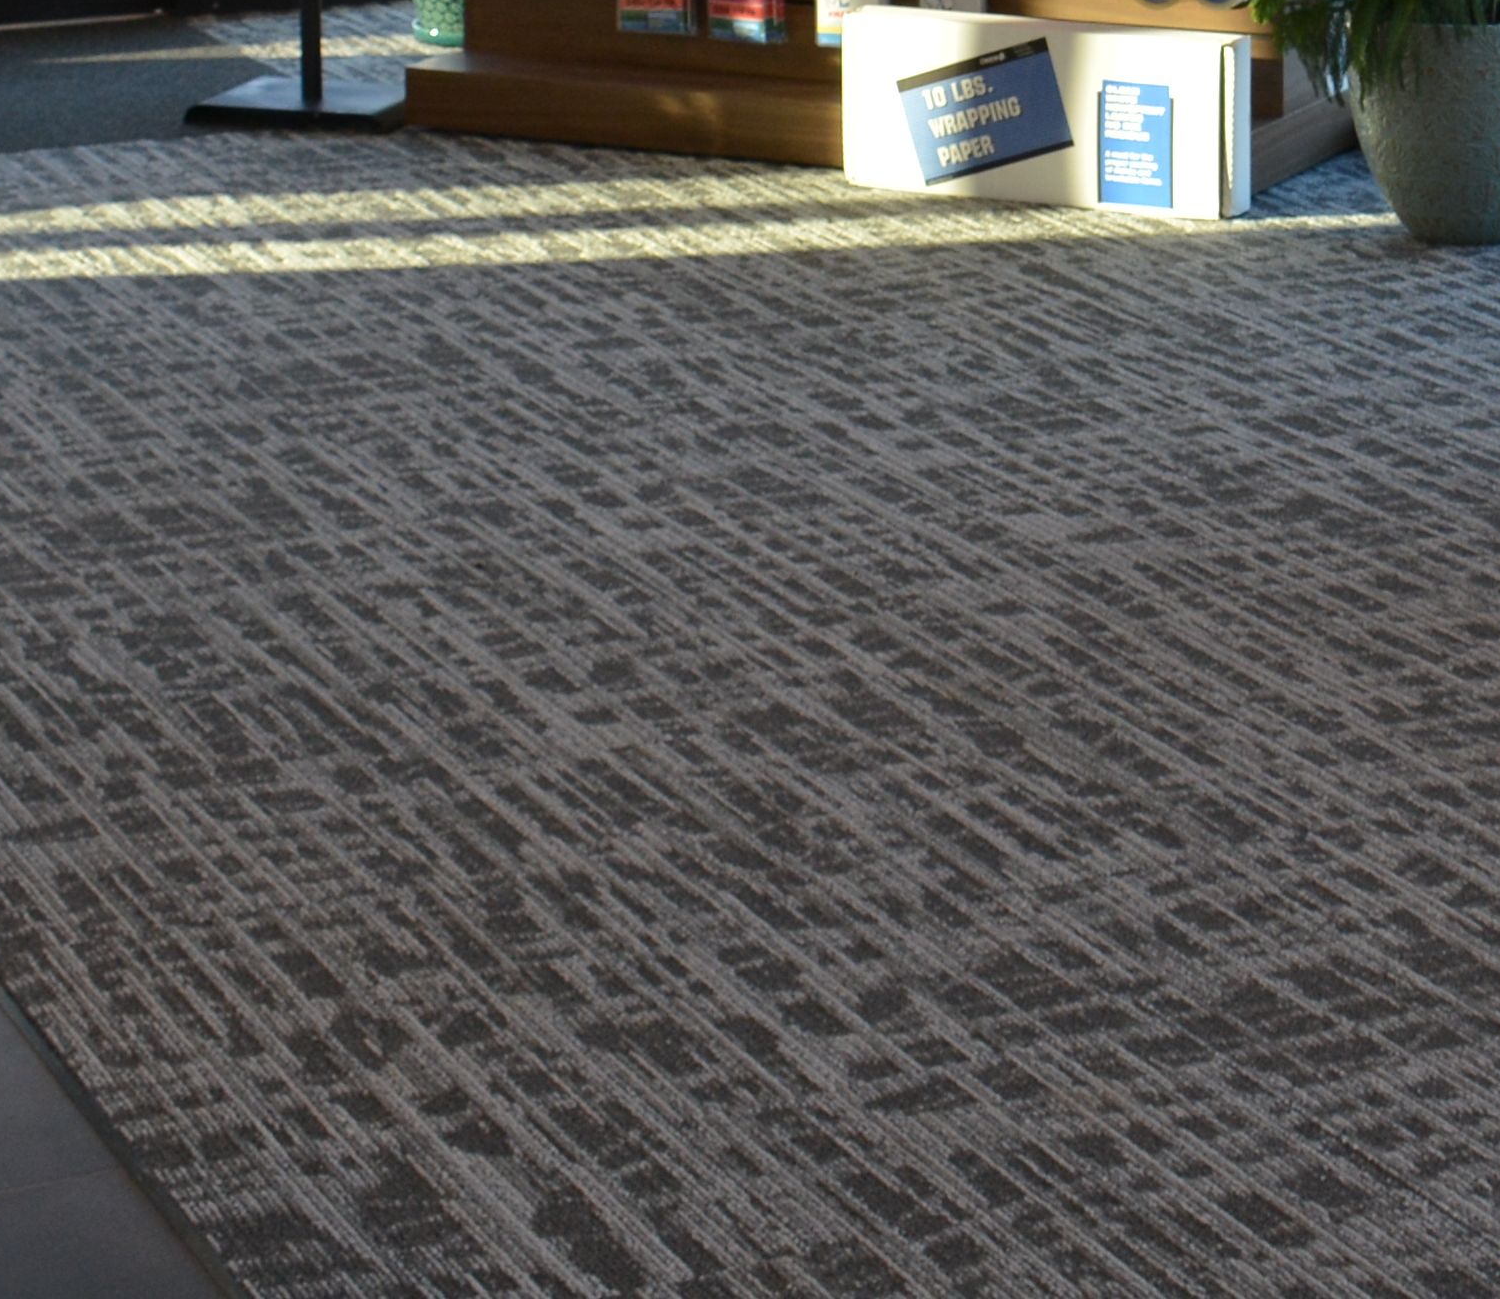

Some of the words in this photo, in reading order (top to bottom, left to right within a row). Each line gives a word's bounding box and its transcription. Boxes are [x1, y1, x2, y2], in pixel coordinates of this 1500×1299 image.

[921, 85, 948, 111] 10
[951, 75, 994, 103] LBS.
[927, 96, 1022, 139] WRAPPING
[936, 135, 995, 168] PAPER
